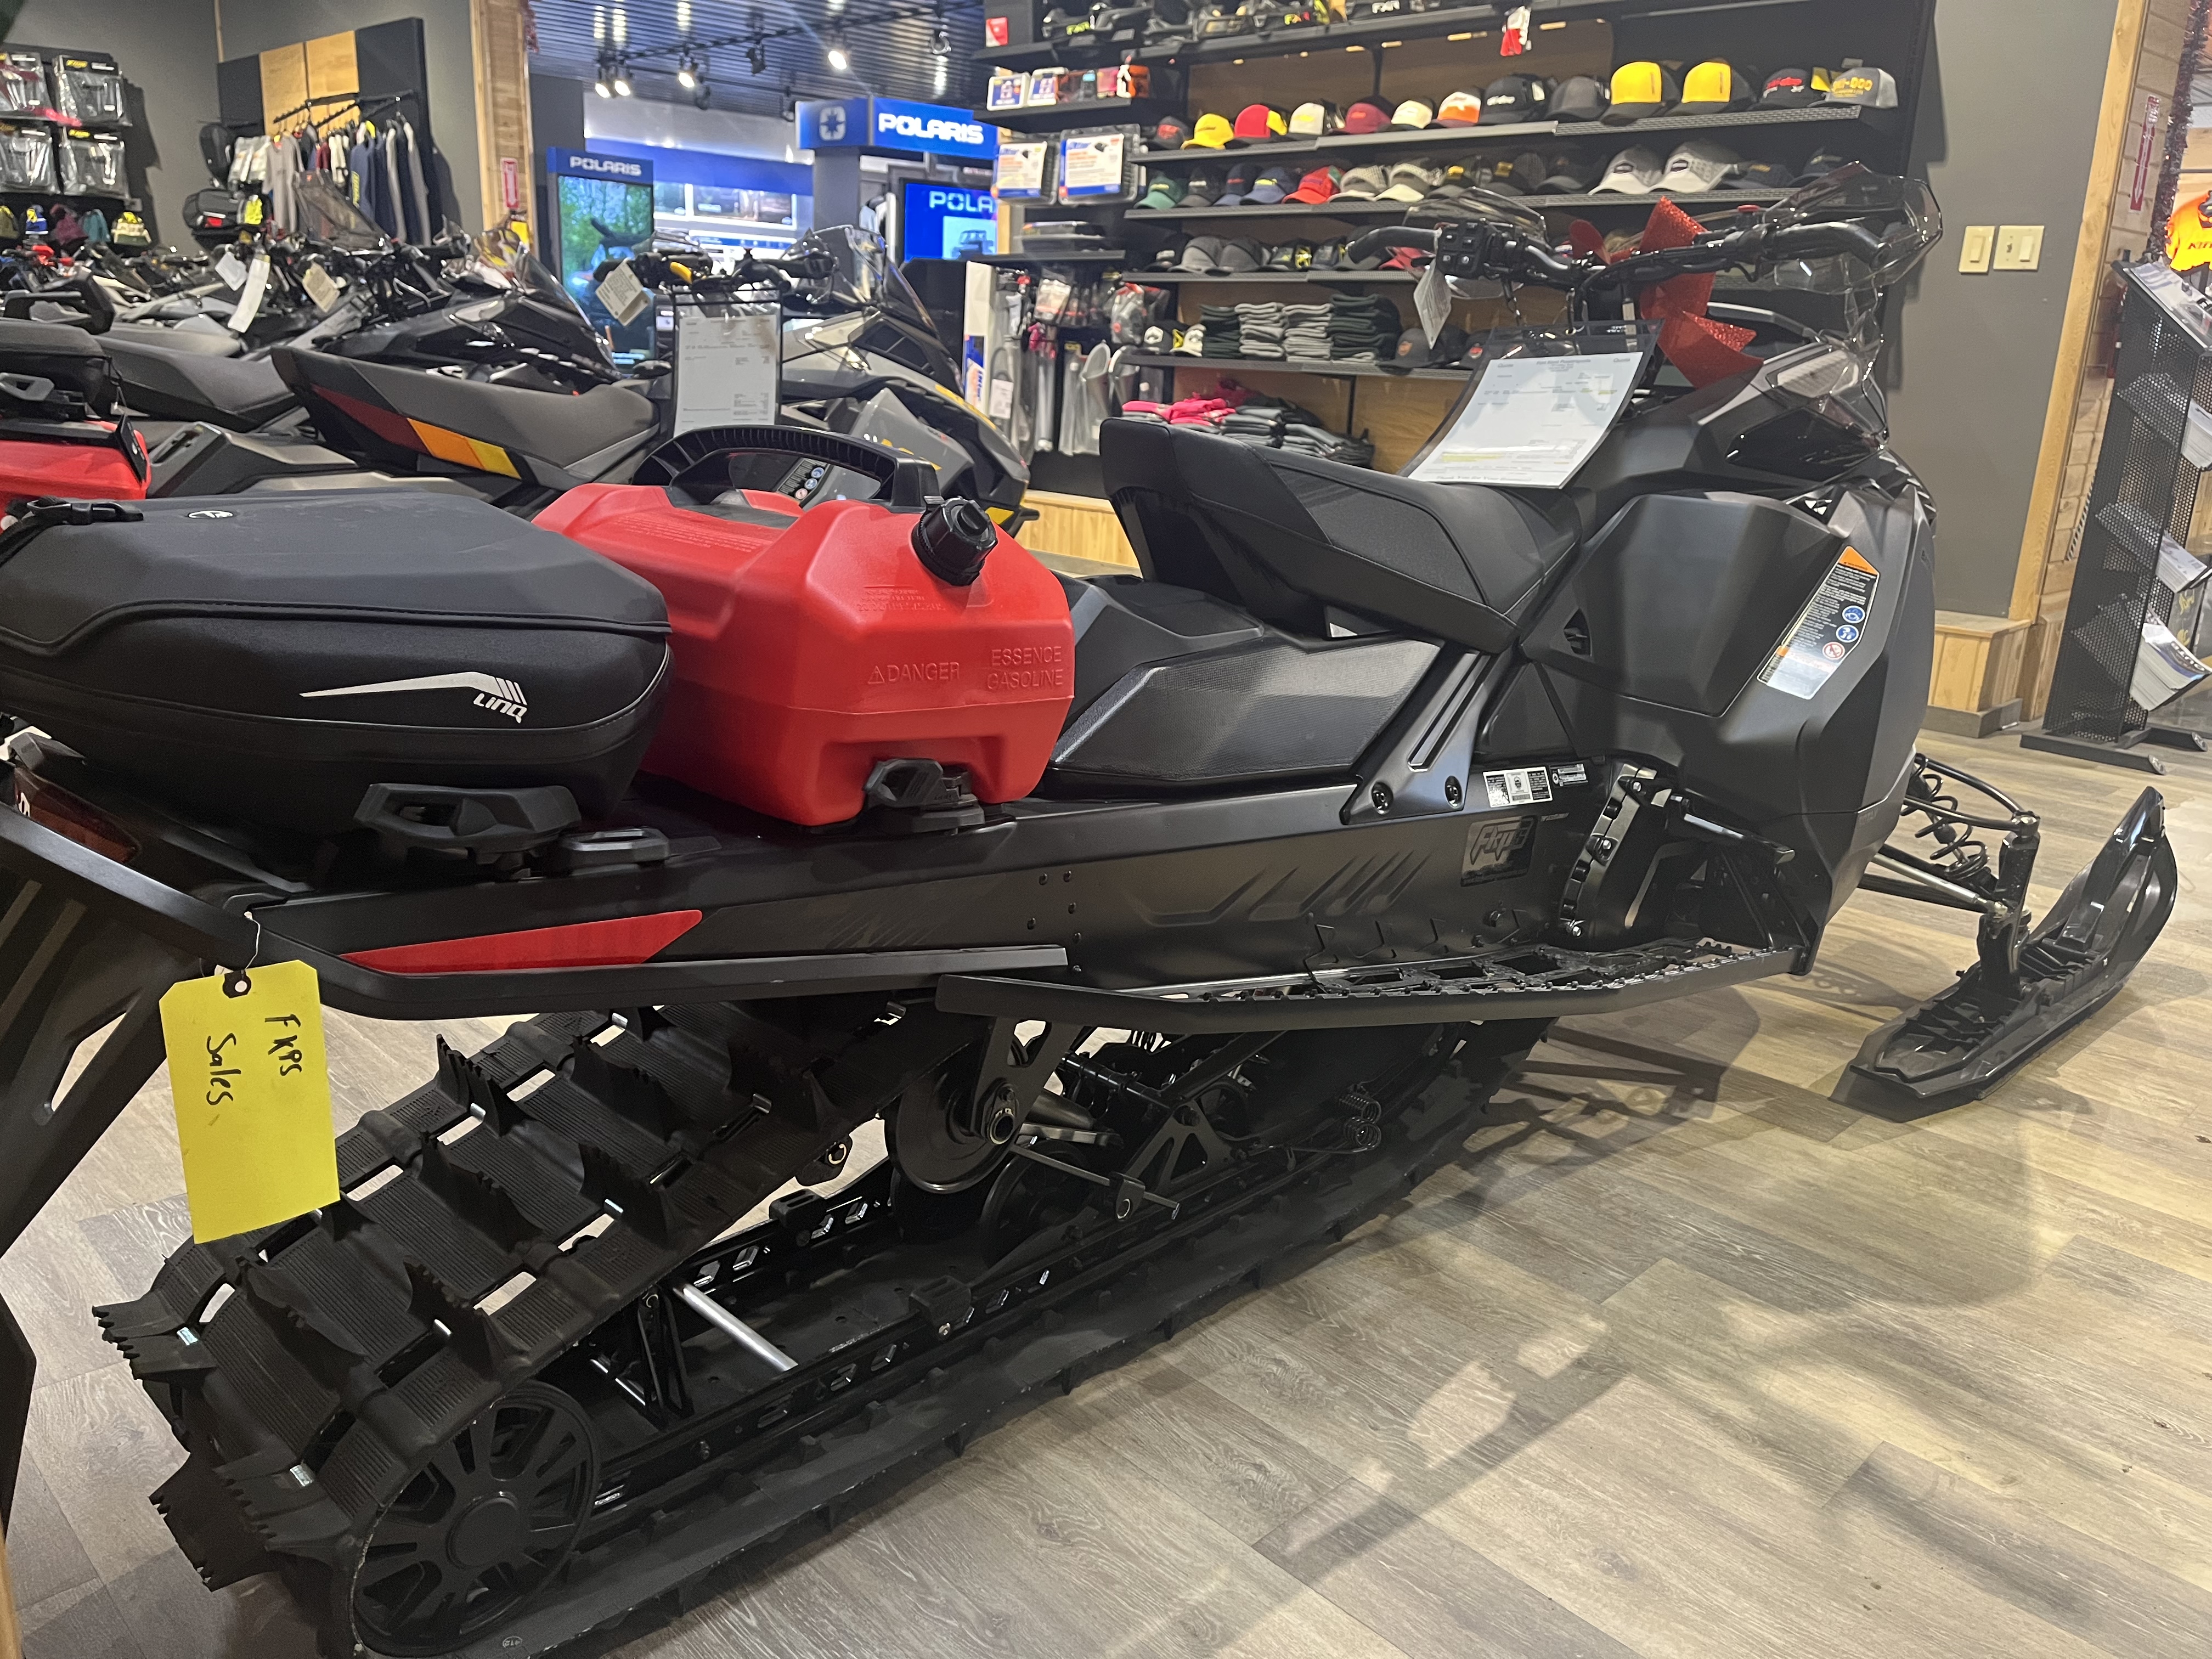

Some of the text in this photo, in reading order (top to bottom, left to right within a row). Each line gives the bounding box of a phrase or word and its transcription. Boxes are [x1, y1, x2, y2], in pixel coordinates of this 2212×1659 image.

[878, 112, 984, 144] POLARIS
[569, 155, 642, 177] POLARIS
[991, 646, 1062, 667] ESSENCE
[887, 661, 960, 682] DANGER
[986, 669, 1063, 690] GASOLINE
[206, 1032, 241, 1105] Sales
